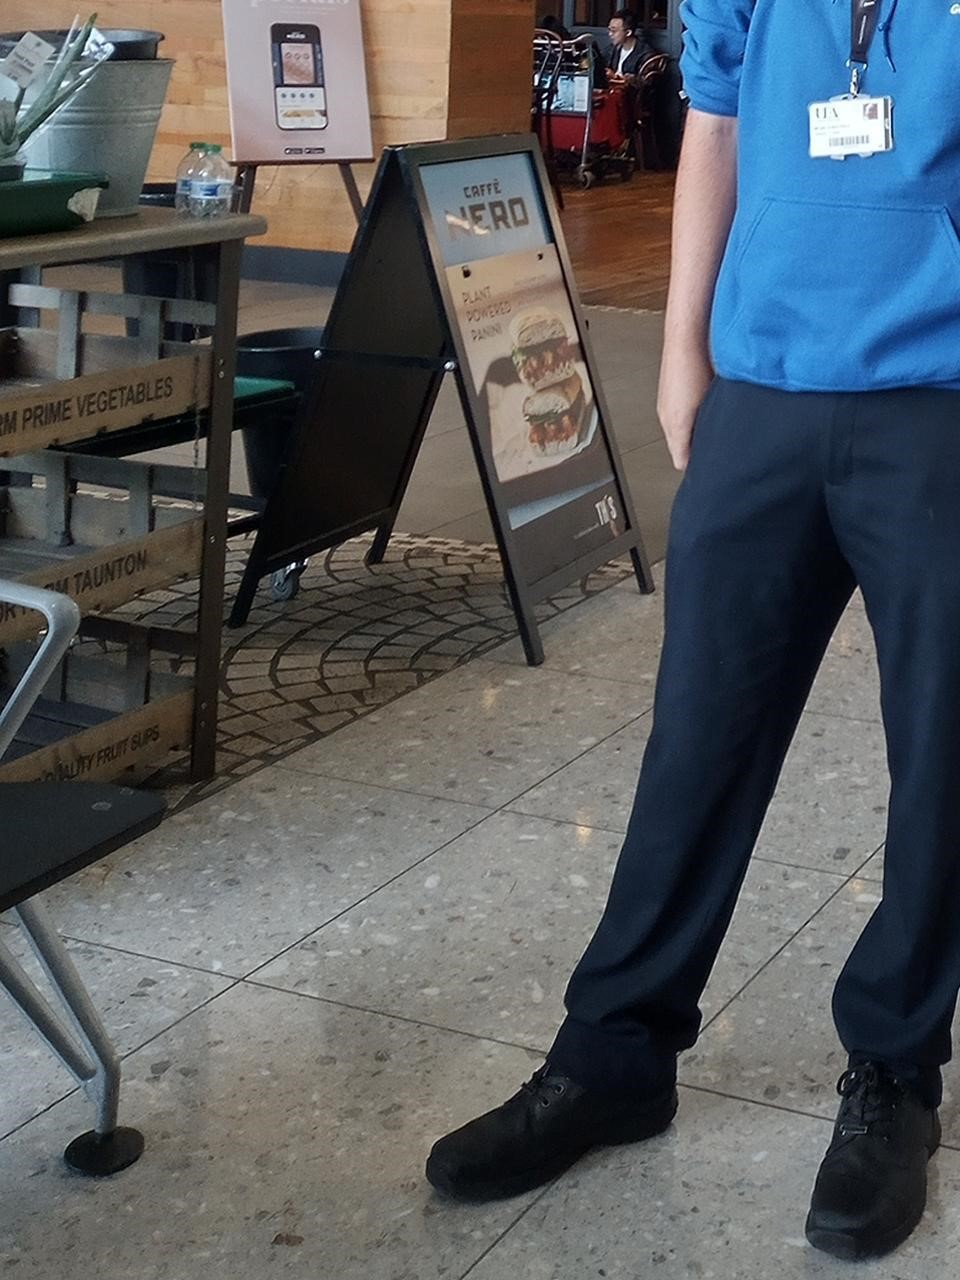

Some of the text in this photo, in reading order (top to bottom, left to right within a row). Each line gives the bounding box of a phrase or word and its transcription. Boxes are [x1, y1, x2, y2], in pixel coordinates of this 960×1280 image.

[444, 196, 530, 241] NERO
[462, 285, 492, 305] PLANT
[22, 397, 72, 431] PRIME
[76, 376, 174, 418] VEGETABLES
[73, 549, 148, 596] TAUNTON
[96, 737, 130, 767] FRUIT
